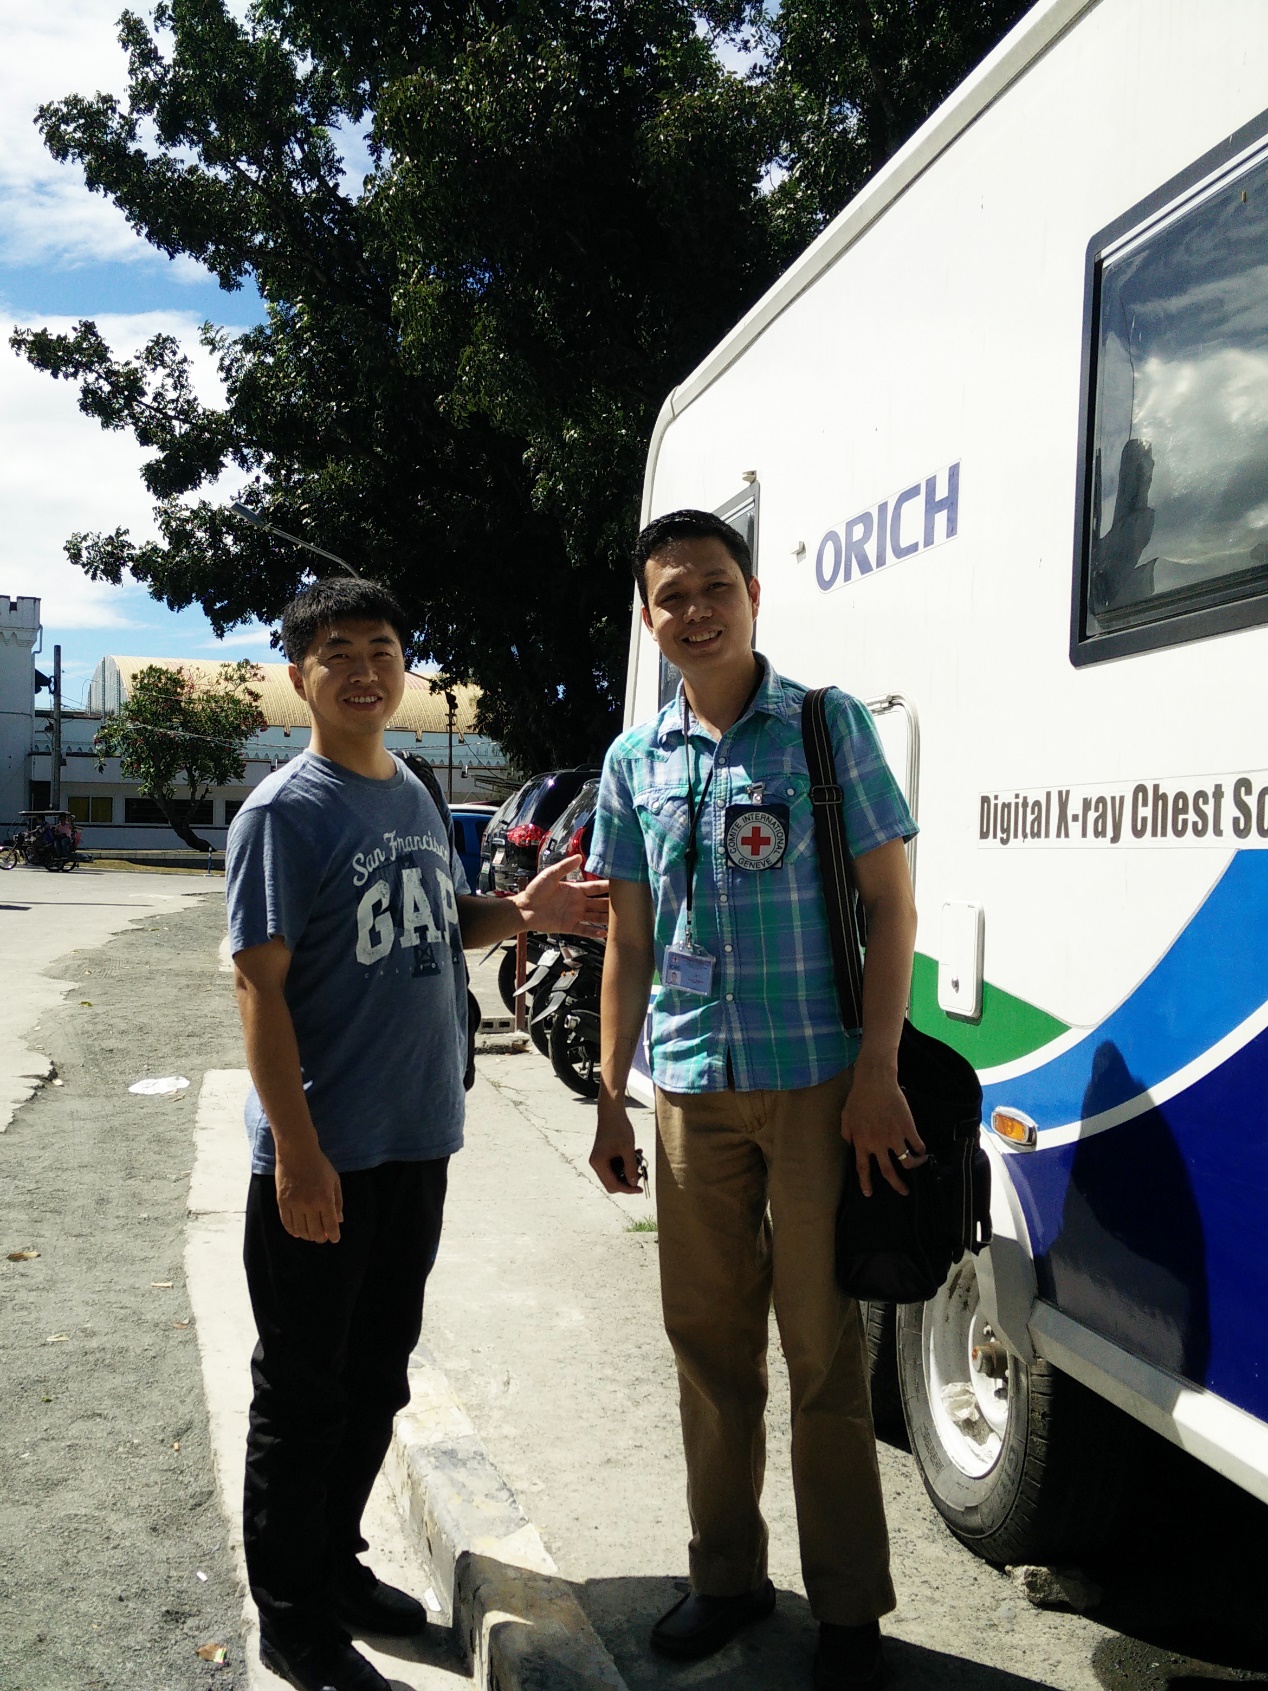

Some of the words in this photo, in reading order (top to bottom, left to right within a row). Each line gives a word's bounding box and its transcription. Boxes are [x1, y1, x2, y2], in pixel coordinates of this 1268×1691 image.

[815, 461, 960, 591] ORICH
[728, 821, 742, 854] COMITE
[741, 813, 784, 854] INTERNATIONAL
[979, 791, 1051, 845] Digital
[1056, 789, 1125, 844] X-ray
[1131, 783, 1224, 839] Chest
[353, 846, 385, 886] San
[738, 857, 773, 869] GENEVE
[356, 867, 458, 965] GAP
